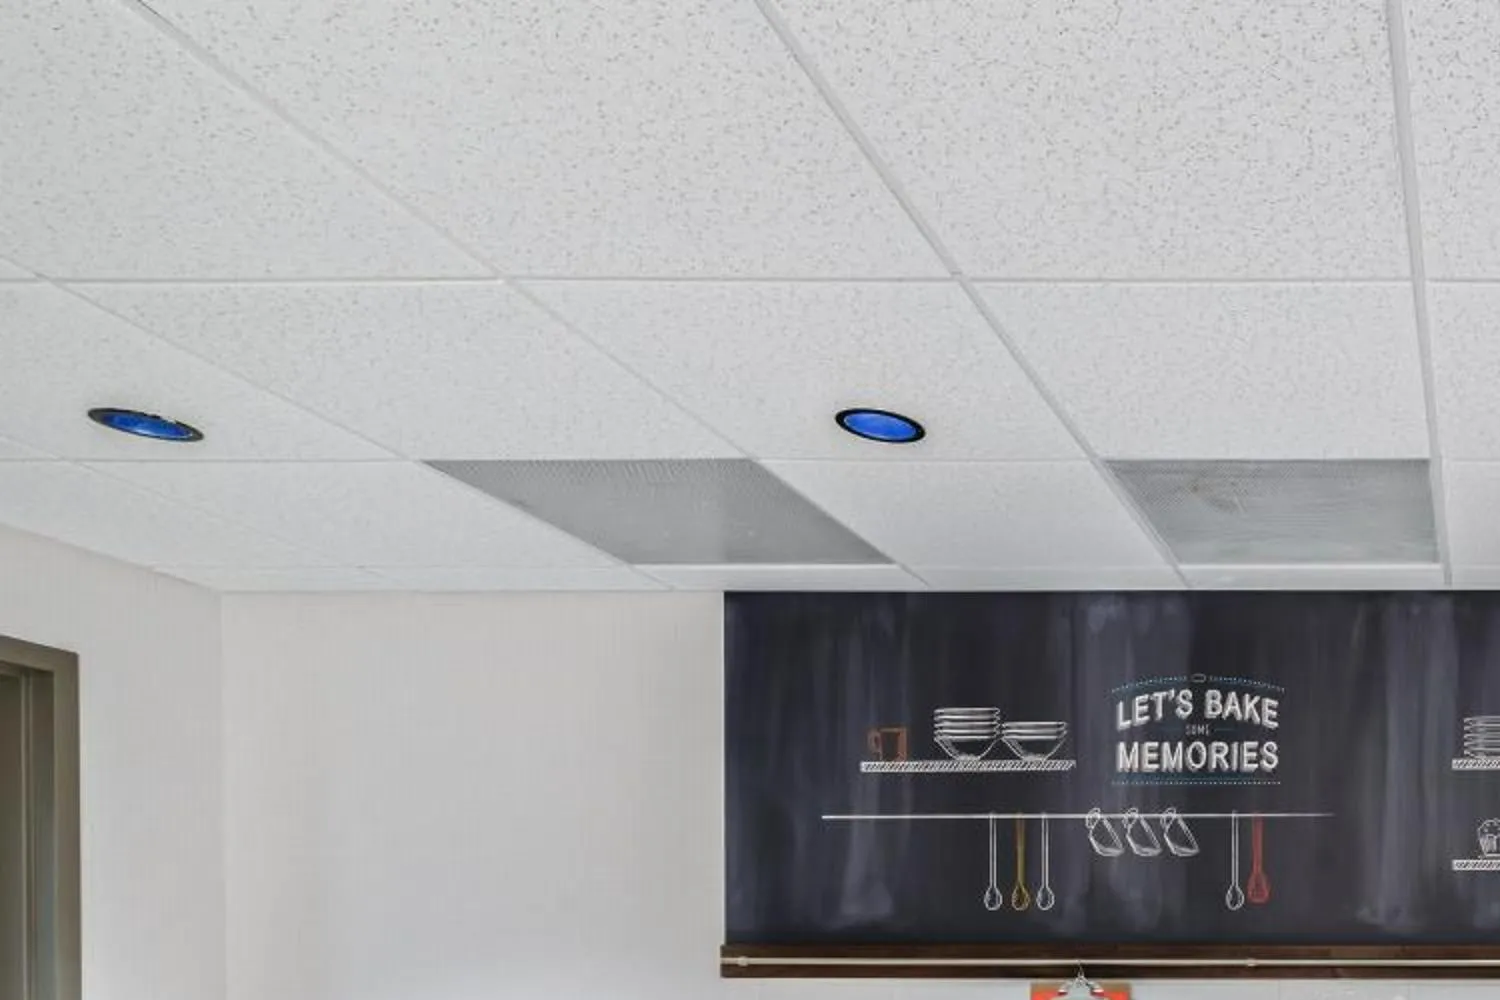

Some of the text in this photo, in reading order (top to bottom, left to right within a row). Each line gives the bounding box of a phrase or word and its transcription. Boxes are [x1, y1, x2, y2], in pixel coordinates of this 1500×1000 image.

[1116, 688, 1279, 731] LET'S BAKE
[1185, 723, 1211, 735] SOME
[1116, 741, 1279, 773] MEMORIES
